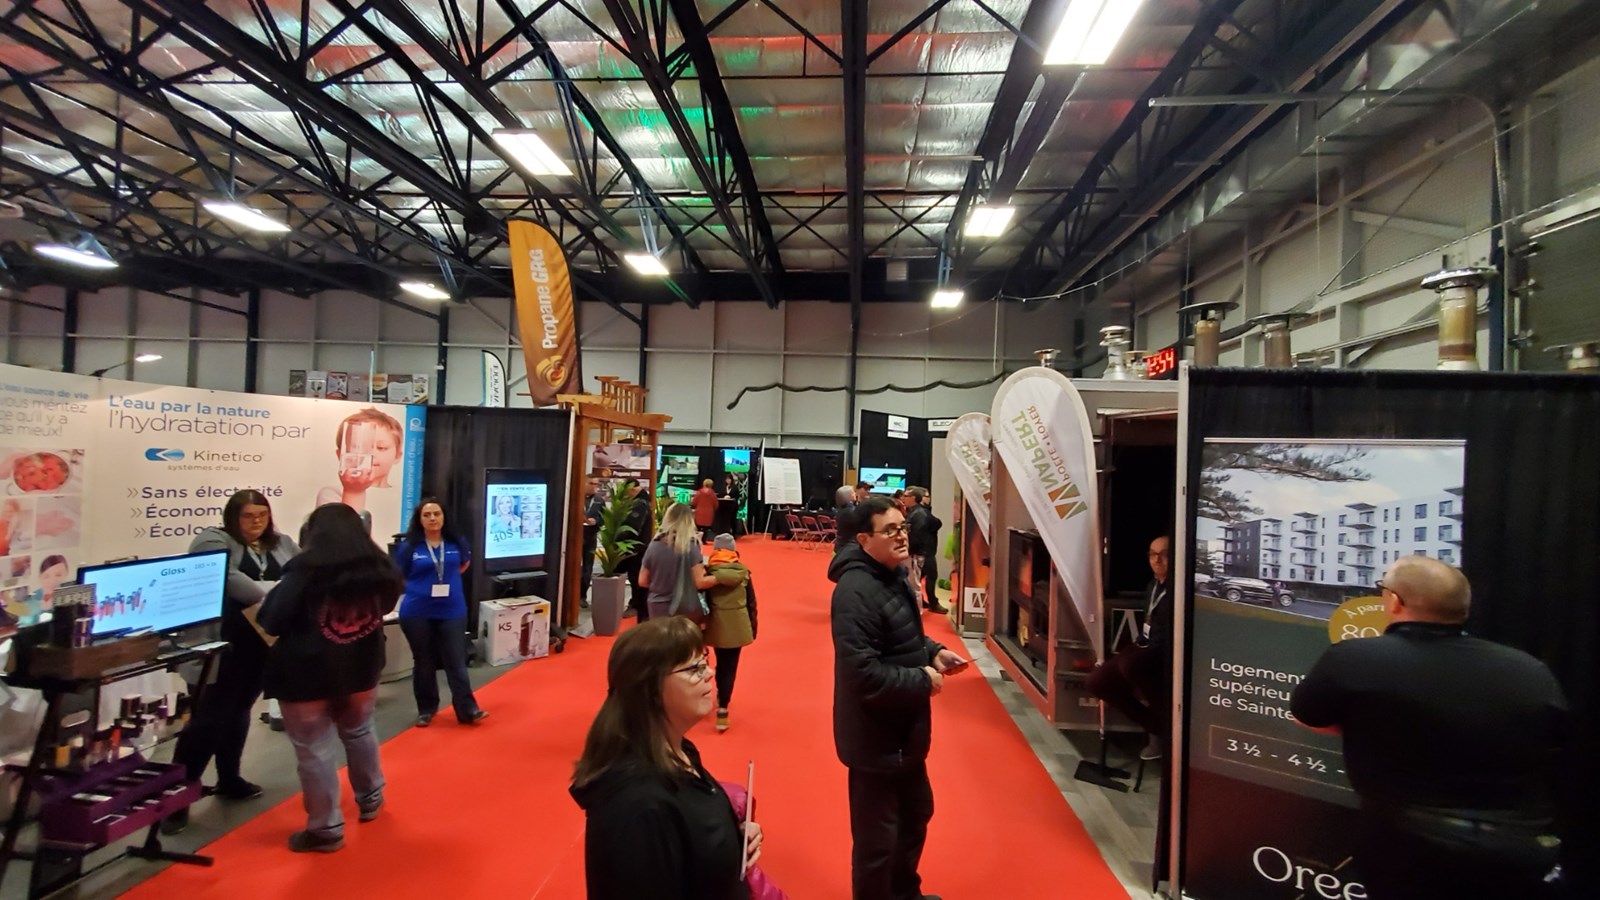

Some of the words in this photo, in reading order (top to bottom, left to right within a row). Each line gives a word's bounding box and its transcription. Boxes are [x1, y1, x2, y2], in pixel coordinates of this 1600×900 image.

[529, 248, 549, 283] GRG
[536, 285, 559, 349] Propane
[109, 395, 155, 411] L'eau
[160, 403, 191, 414] par
[197, 403, 211, 415] la
[217, 407, 271, 419] nature
[46, 415, 55, 425] y
[59, 414, 68, 424] a
[109, 409, 264, 437] l'hydratation
[272, 424, 311, 440] par
[194, 450, 263, 463] Kinetico
[141, 486, 188, 499] Sans
[195, 485, 283, 498] électité
[146, 503, 223, 519] Économ
[160, 567, 186, 577] Gloss
[498, 621, 513, 632] K5
[1209, 677, 1291, 701] supérieu
[1209, 693, 1233, 708] de
[1237, 698, 1296, 721] Sainte
[1226, 738, 1239, 752] 3
[1287, 753, 1302, 766] 4
